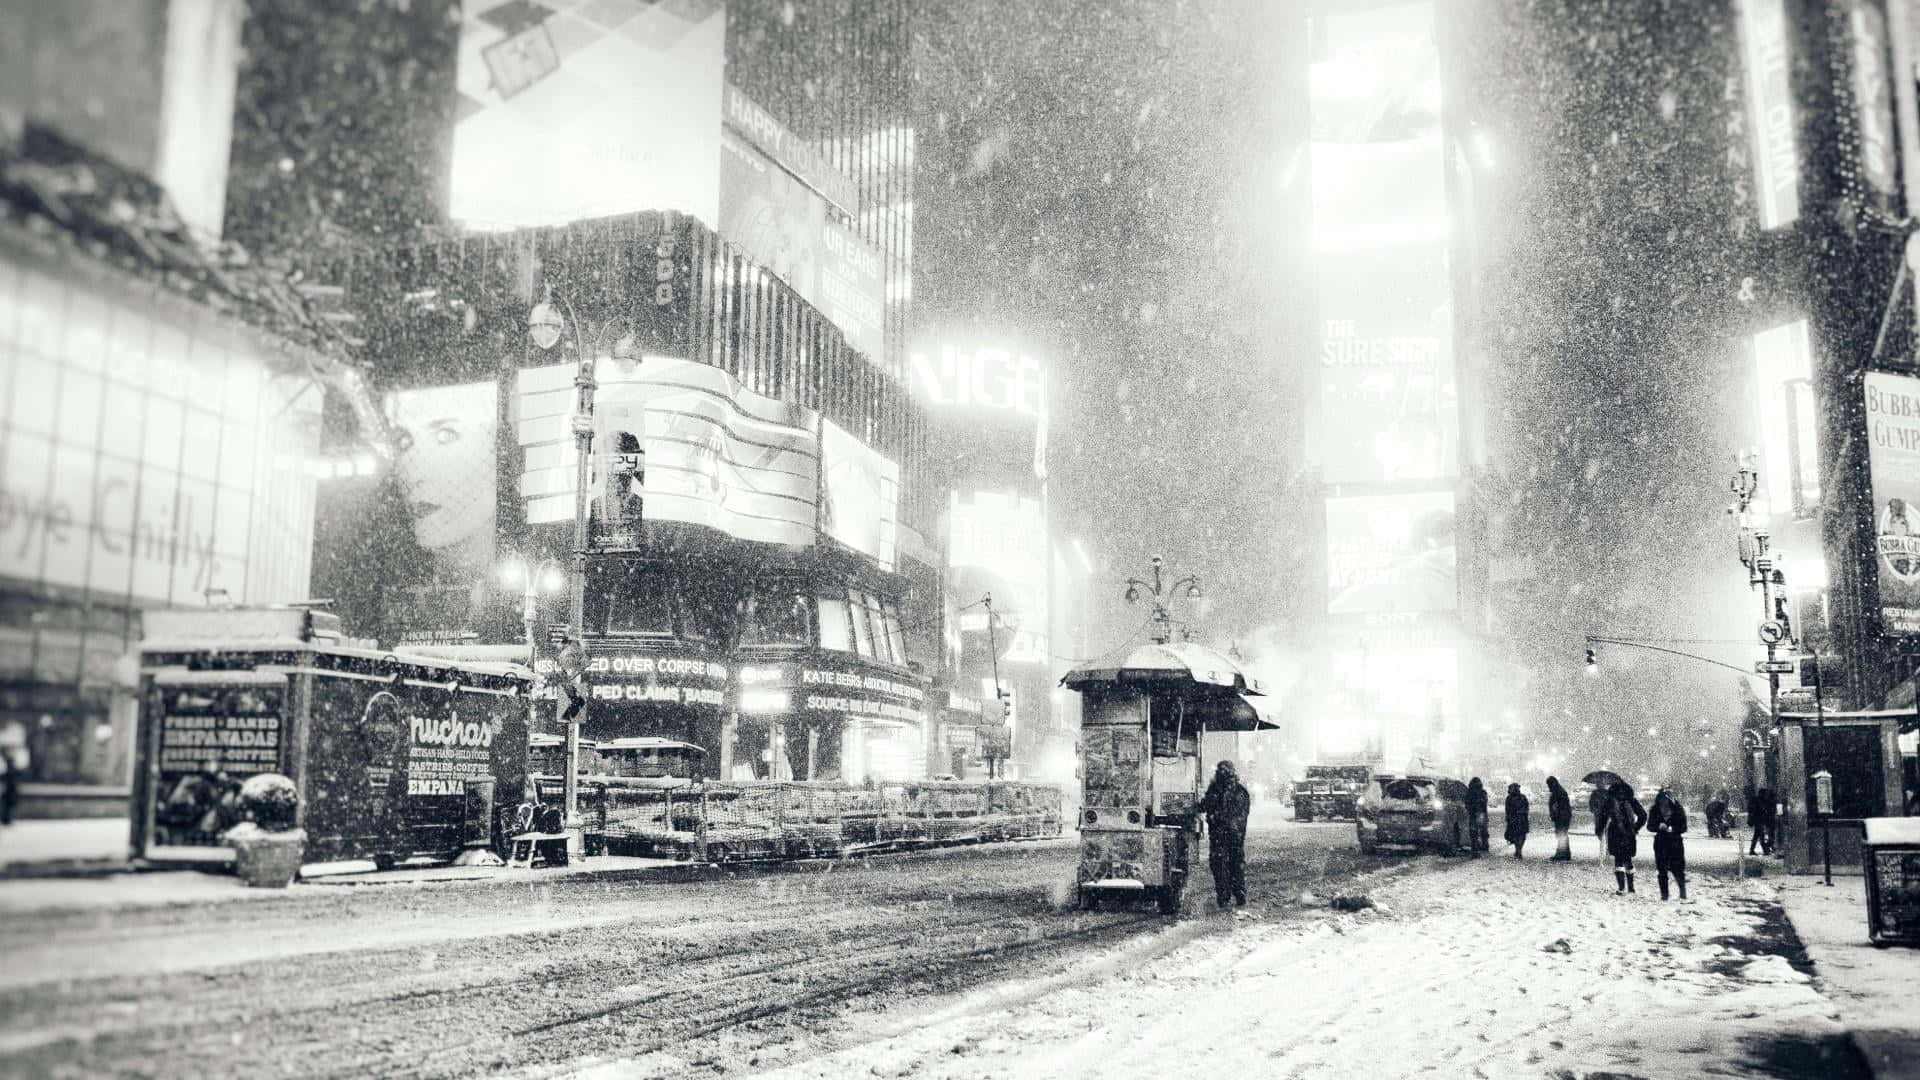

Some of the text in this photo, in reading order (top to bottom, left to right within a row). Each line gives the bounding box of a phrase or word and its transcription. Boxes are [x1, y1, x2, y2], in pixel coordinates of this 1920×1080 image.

[730, 91, 783, 150] HAPPY
[1326, 319, 1356, 337] THE
[1322, 338, 1381, 368] SURE
[613, 656, 654, 673] OVER
[657, 657, 705, 675] CORPSE
[803, 669, 834, 684] KATIE
[626, 685, 680, 702] CLAIMS
[163, 729, 278, 748] EMPANADAS
[410, 711, 491, 747] nuchas
[407, 780, 465, 796] EMPANA
